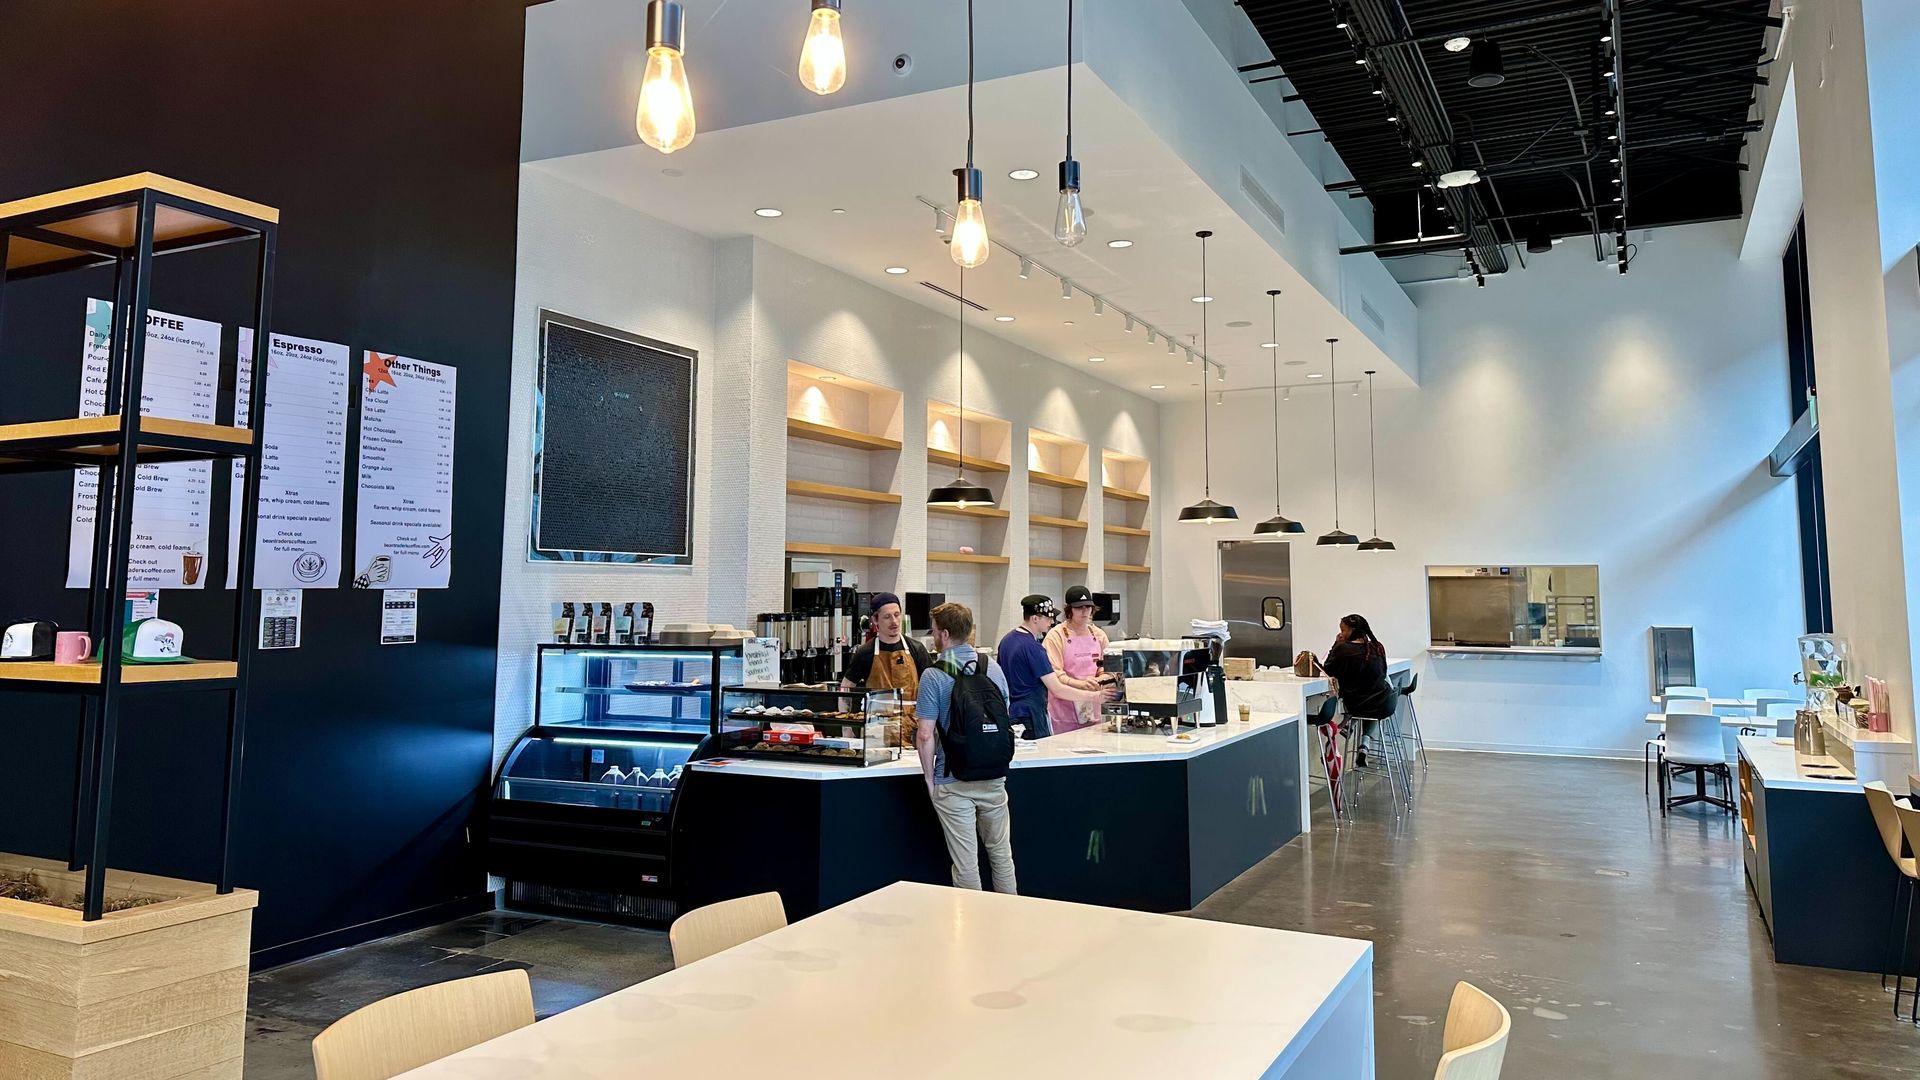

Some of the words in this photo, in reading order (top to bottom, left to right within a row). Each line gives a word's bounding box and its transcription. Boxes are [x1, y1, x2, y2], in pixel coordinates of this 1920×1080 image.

[146, 315, 184, 331] OFFEE
[90, 330, 106, 340] Daily
[161, 334, 174, 342] 24oz
[190, 340, 206, 348] only)
[273, 338, 322, 354] Espresso
[384, 359, 410, 370] Other
[412, 364, 441, 378] Things
